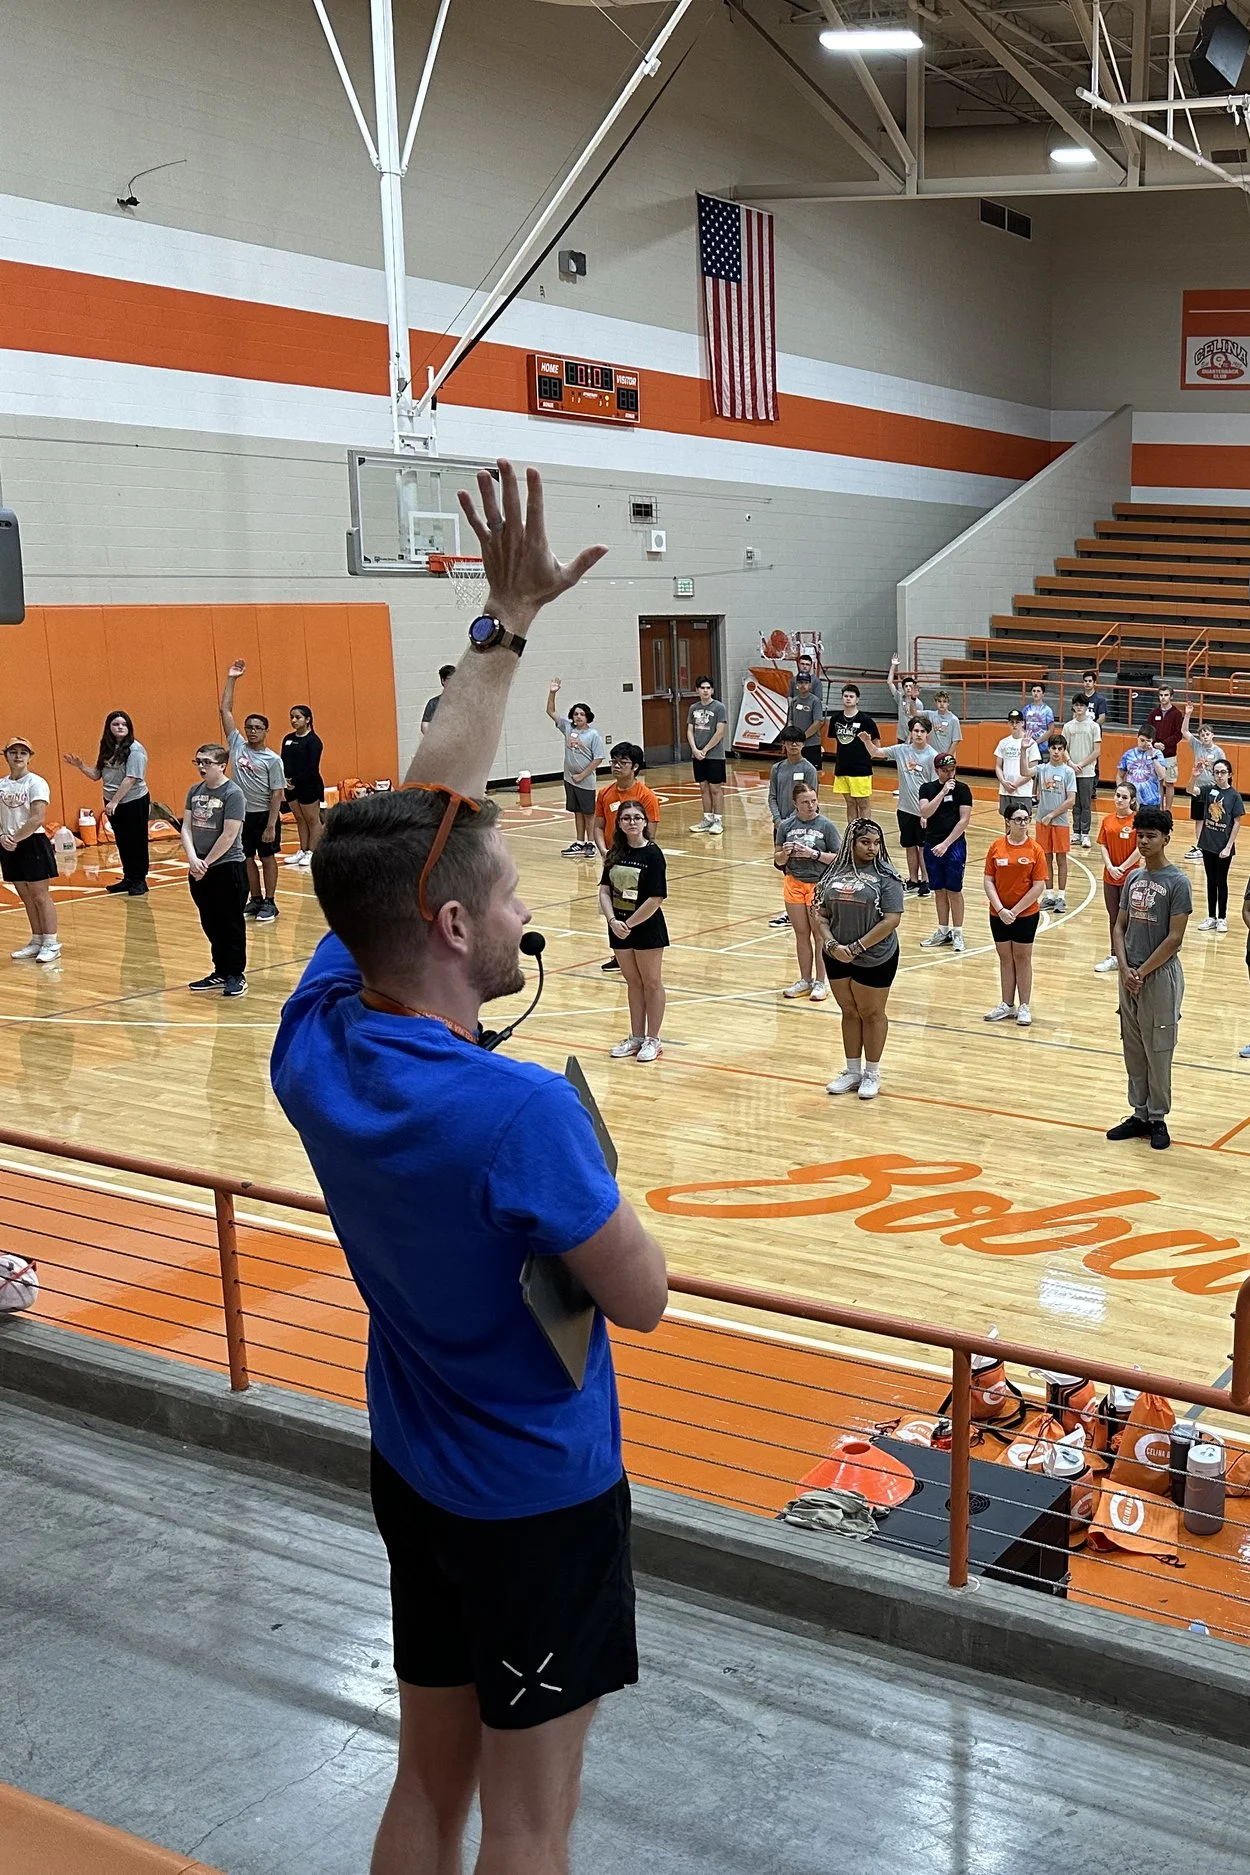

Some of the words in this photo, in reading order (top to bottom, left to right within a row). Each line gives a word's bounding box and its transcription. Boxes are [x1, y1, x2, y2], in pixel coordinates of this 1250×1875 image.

[1194, 339, 1248, 368] CELINA
[540, 362, 559, 374] HOME
[616, 374, 637, 387] VISITOR
[1146, 1447, 1166, 1458] CELINA
